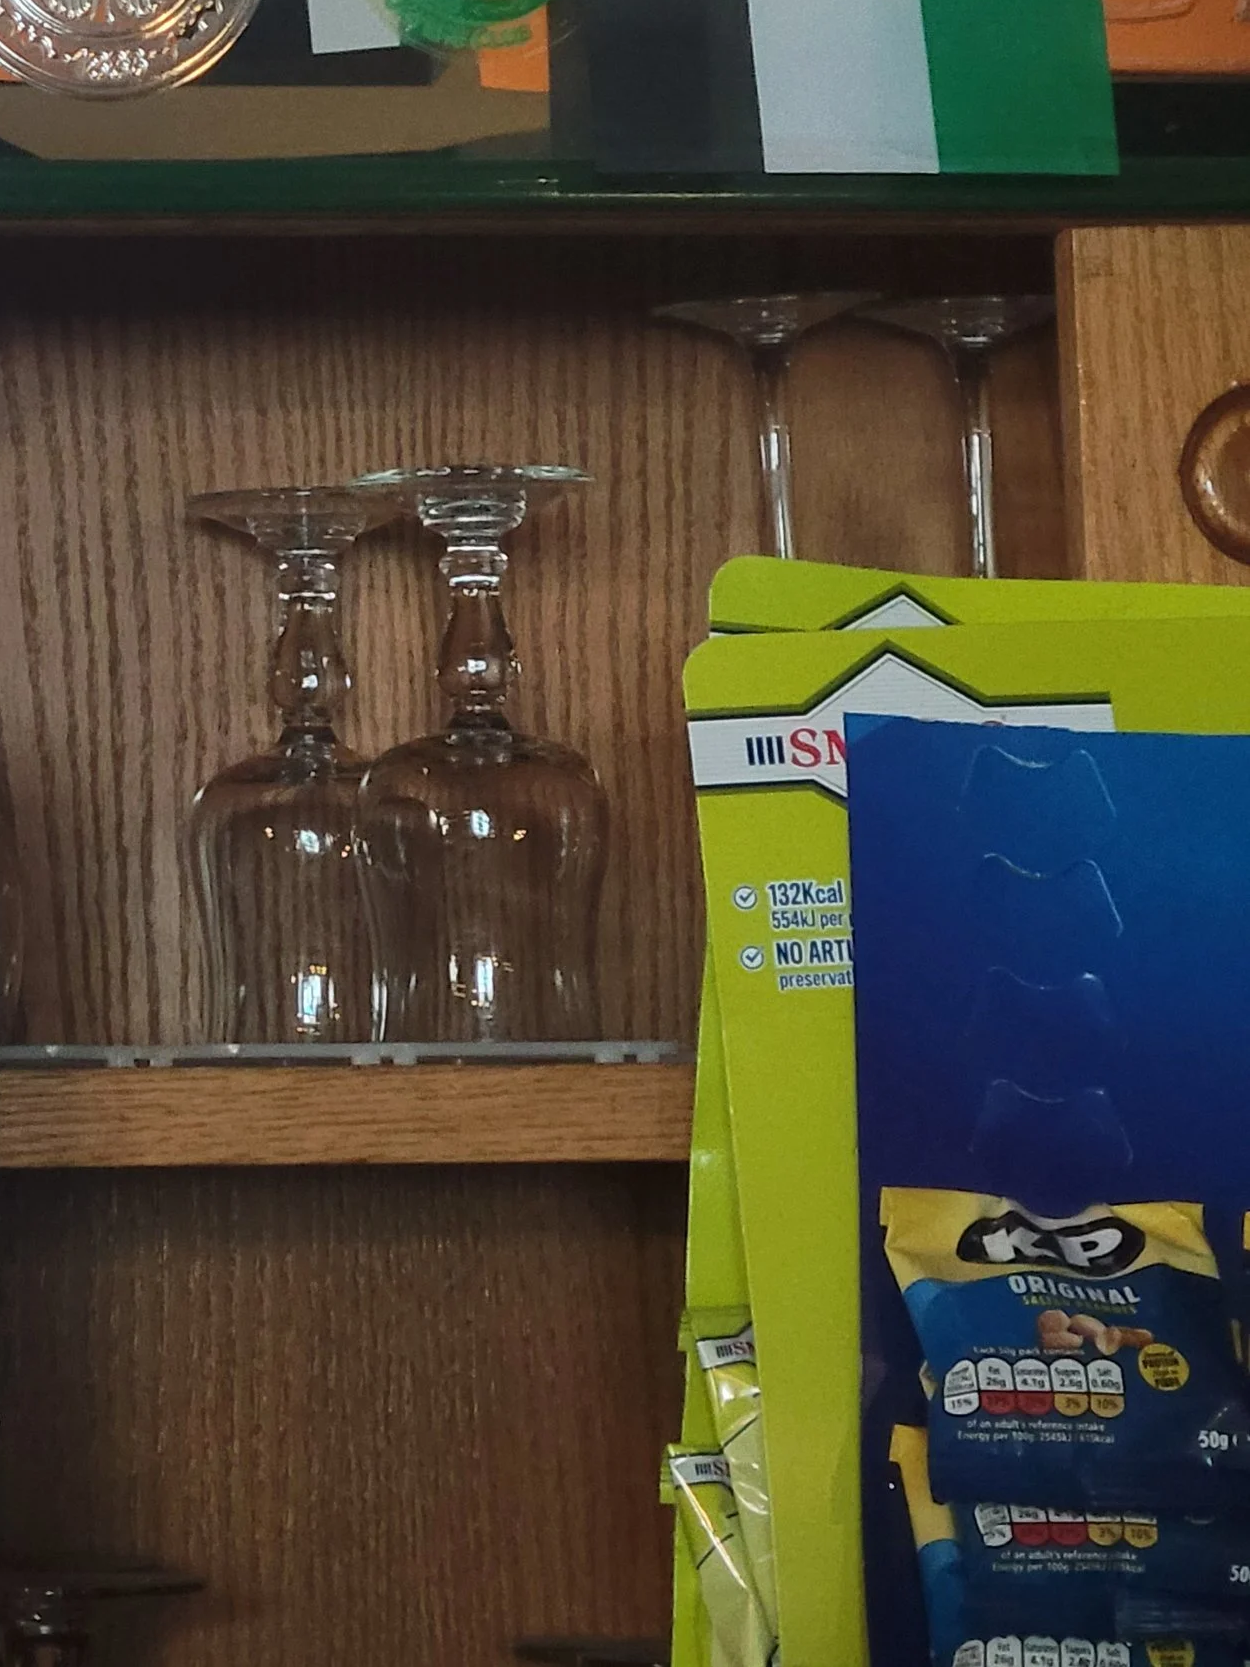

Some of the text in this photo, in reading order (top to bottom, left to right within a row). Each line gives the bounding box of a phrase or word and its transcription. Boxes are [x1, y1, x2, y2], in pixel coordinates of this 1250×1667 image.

[766, 880, 845, 908] 132Kcal
[770, 911, 844, 933] 554kJ per
[774, 941, 806, 966] NO
[778, 969, 855, 992] preservat
[982, 1227, 1124, 1268] KP
[1007, 1274, 1141, 1305] ORIGINAL
[951, 1398, 973, 1409] 15%
[967, 1419, 979, 1429] of
[979, 1421, 992, 1430] an
[1197, 1430, 1230, 1451] 50g
[1230, 1564, 1250, 1584] 50
